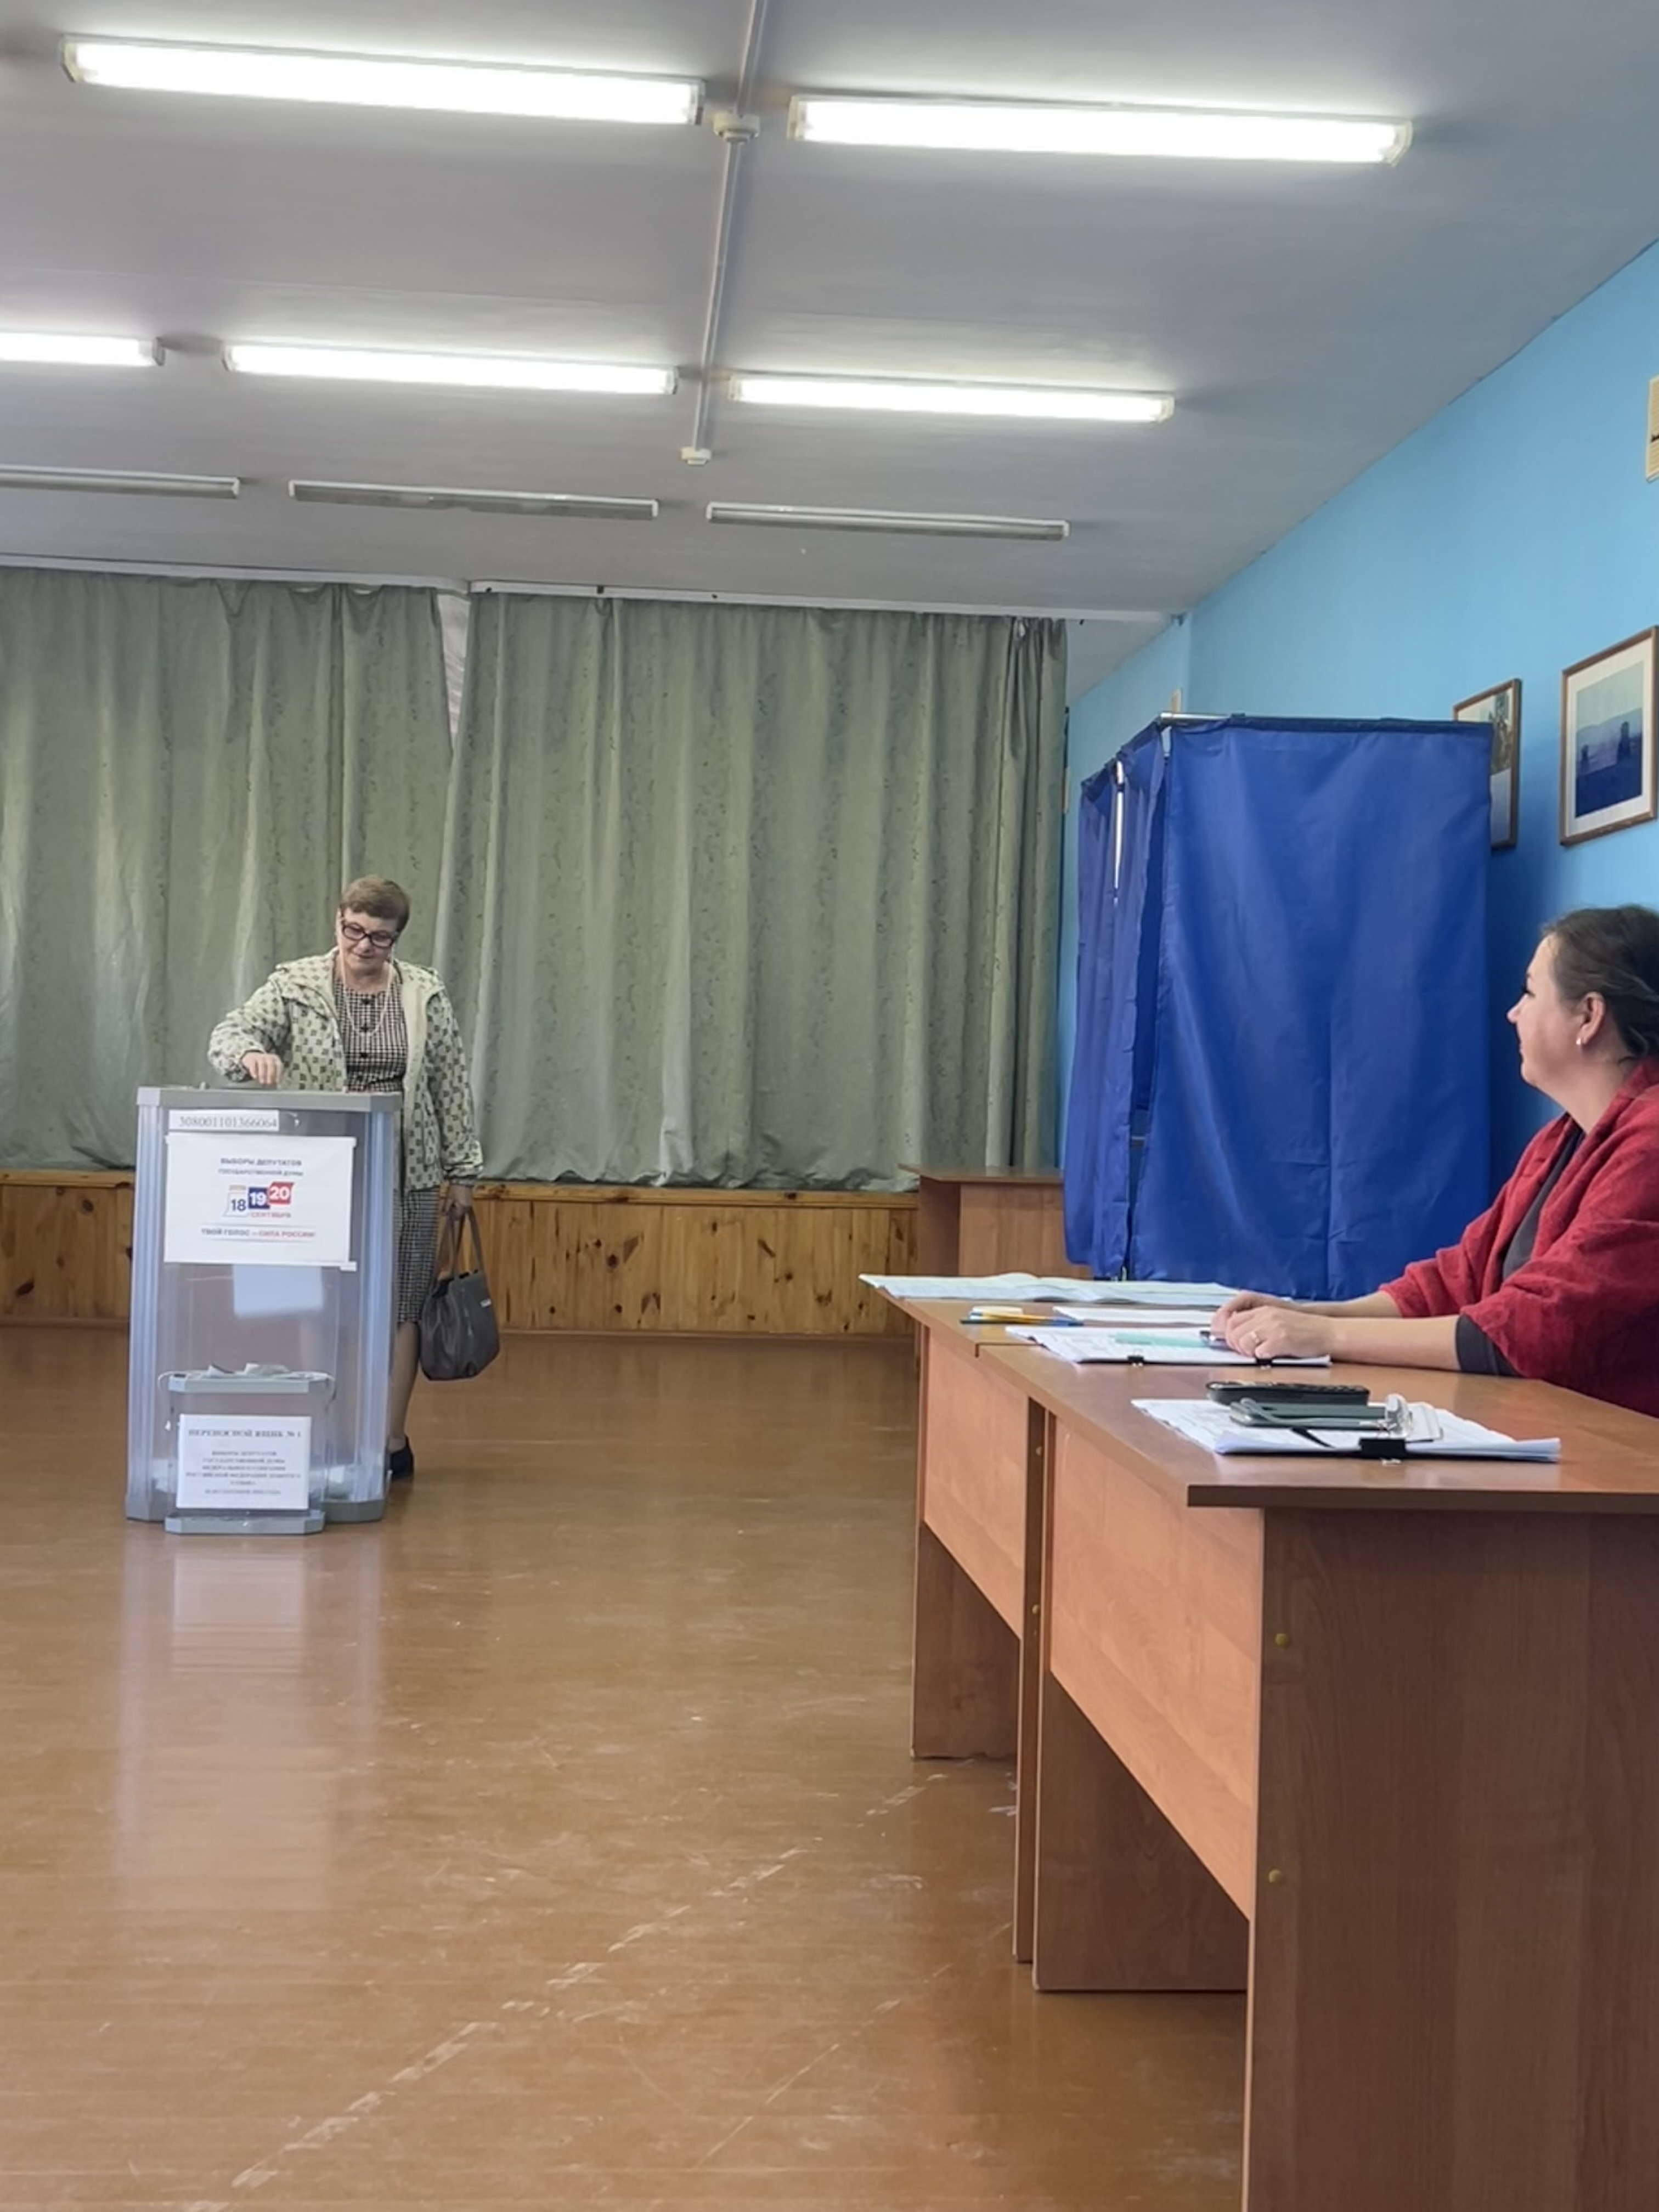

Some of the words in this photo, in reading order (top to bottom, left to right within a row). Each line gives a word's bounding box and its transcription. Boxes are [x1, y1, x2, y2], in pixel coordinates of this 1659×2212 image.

[231, 1199, 246, 1212] 18
[250, 1192, 267, 1206] 19
[269, 1186, 290, 1200] 20
